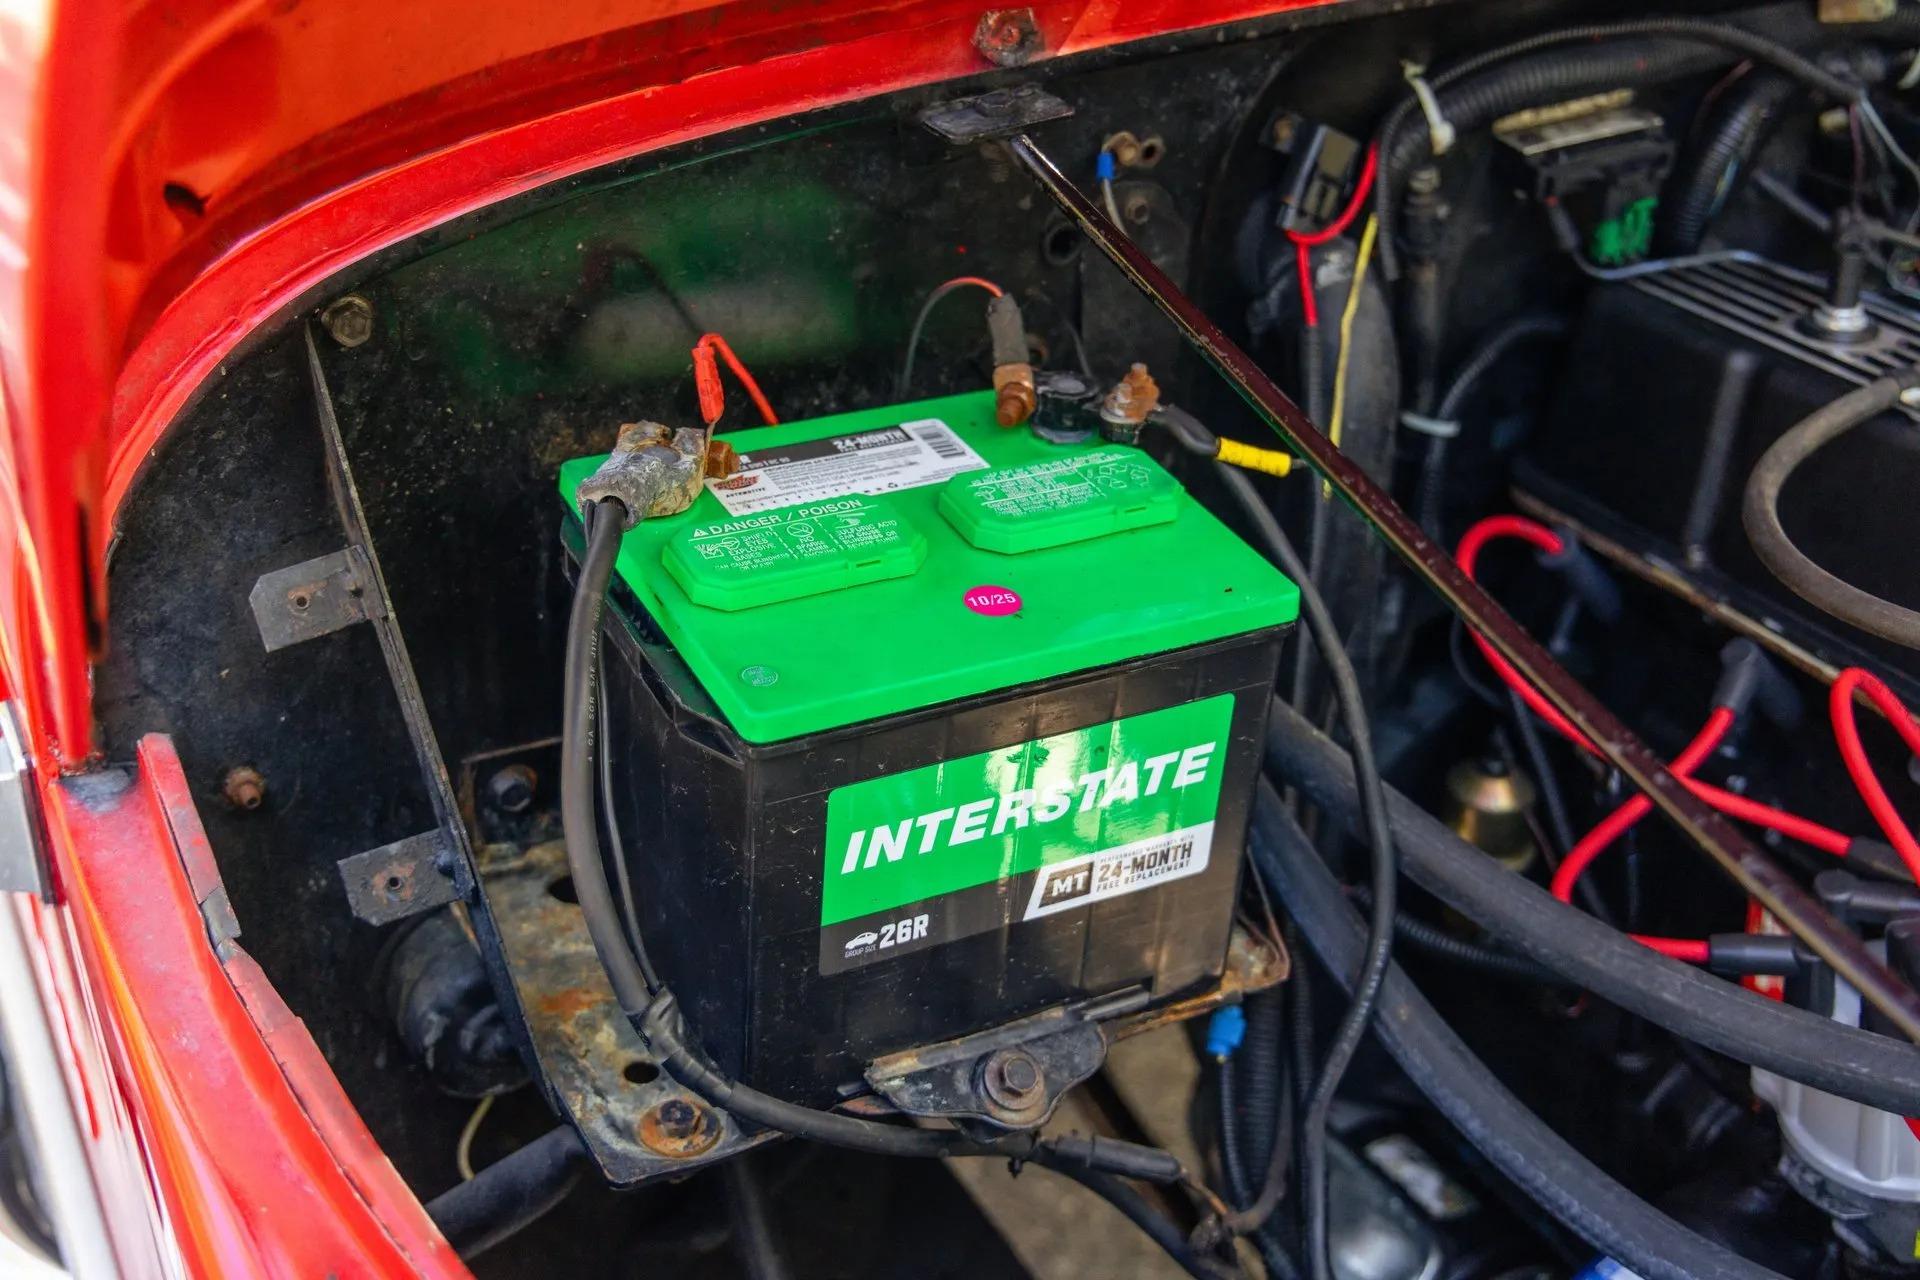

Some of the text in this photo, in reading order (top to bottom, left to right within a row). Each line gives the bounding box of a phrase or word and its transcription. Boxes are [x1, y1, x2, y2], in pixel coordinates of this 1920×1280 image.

[709, 514, 782, 535] DANGER
[798, 499, 863, 518] POISON
[836, 519, 897, 535] SULFURIC ACID
[799, 535, 815, 544] NO
[967, 592, 1017, 608] 10/25
[841, 741, 1217, 875] INTERSTATE
[1051, 840, 1193, 897] MT 24-MONTH
[1096, 858, 1191, 893] FREE REPLACEMENT
[879, 912, 930, 949] 26R
[844, 946, 864, 958] GROUP
